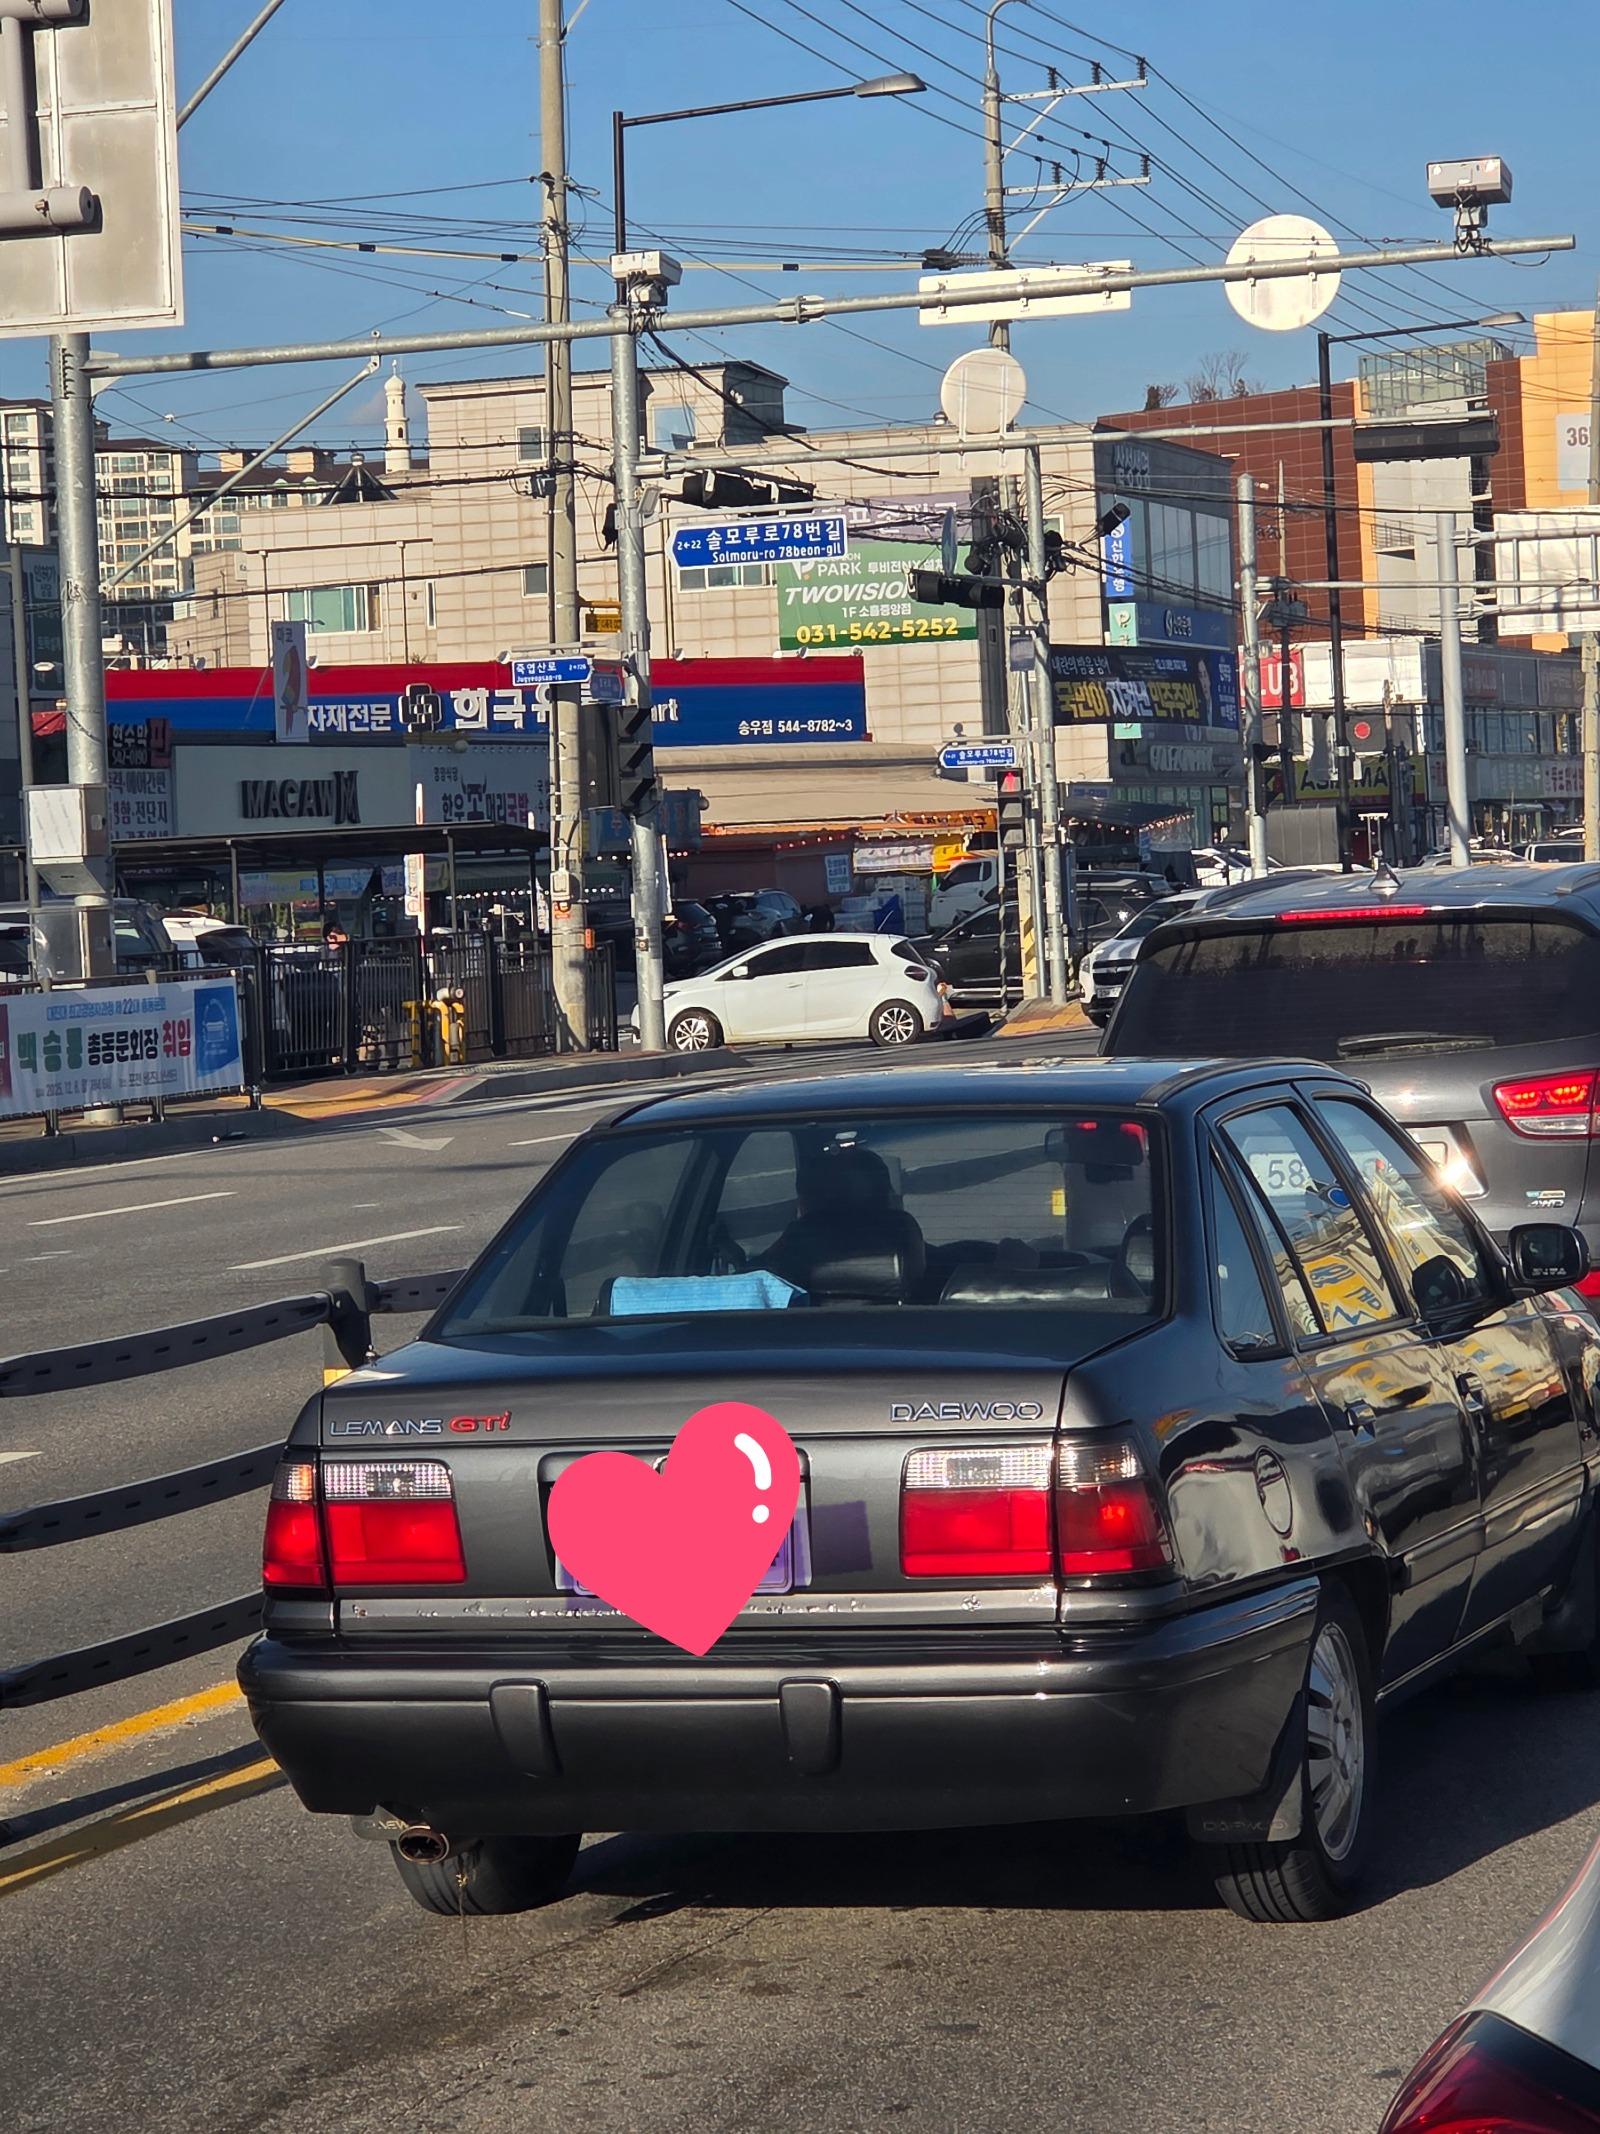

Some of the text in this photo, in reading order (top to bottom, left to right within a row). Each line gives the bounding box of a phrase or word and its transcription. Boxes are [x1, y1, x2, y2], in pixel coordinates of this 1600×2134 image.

[1566, 426, 1591, 447] 36
[706, 520, 841, 550] 솔모루로78번길
[712, 549, 776, 564] Solmoru-ro
[778, 542, 842, 560] 78beon-gil
[817, 562, 862, 578] PARK
[841, 607, 857, 618] 1F
[796, 617, 960, 645] 031-542-5252
[516, 661, 557, 675] 죽엽산로
[1055, 681, 1111, 718] 국민이
[1106, 679, 1154, 718] 지켜낸
[1150, 681, 1200, 719] 민주주의!
[738, 718, 854, 736] 송우점 544-8782~3
[241, 778, 334, 820] MACAW
[87, 1028, 159, 1066] 총동문회장
[162, 1018, 191, 1058] 취임
[890, 1400, 1045, 1423] DAEWOO
[330, 1410, 513, 1437] LEMANS GTi
